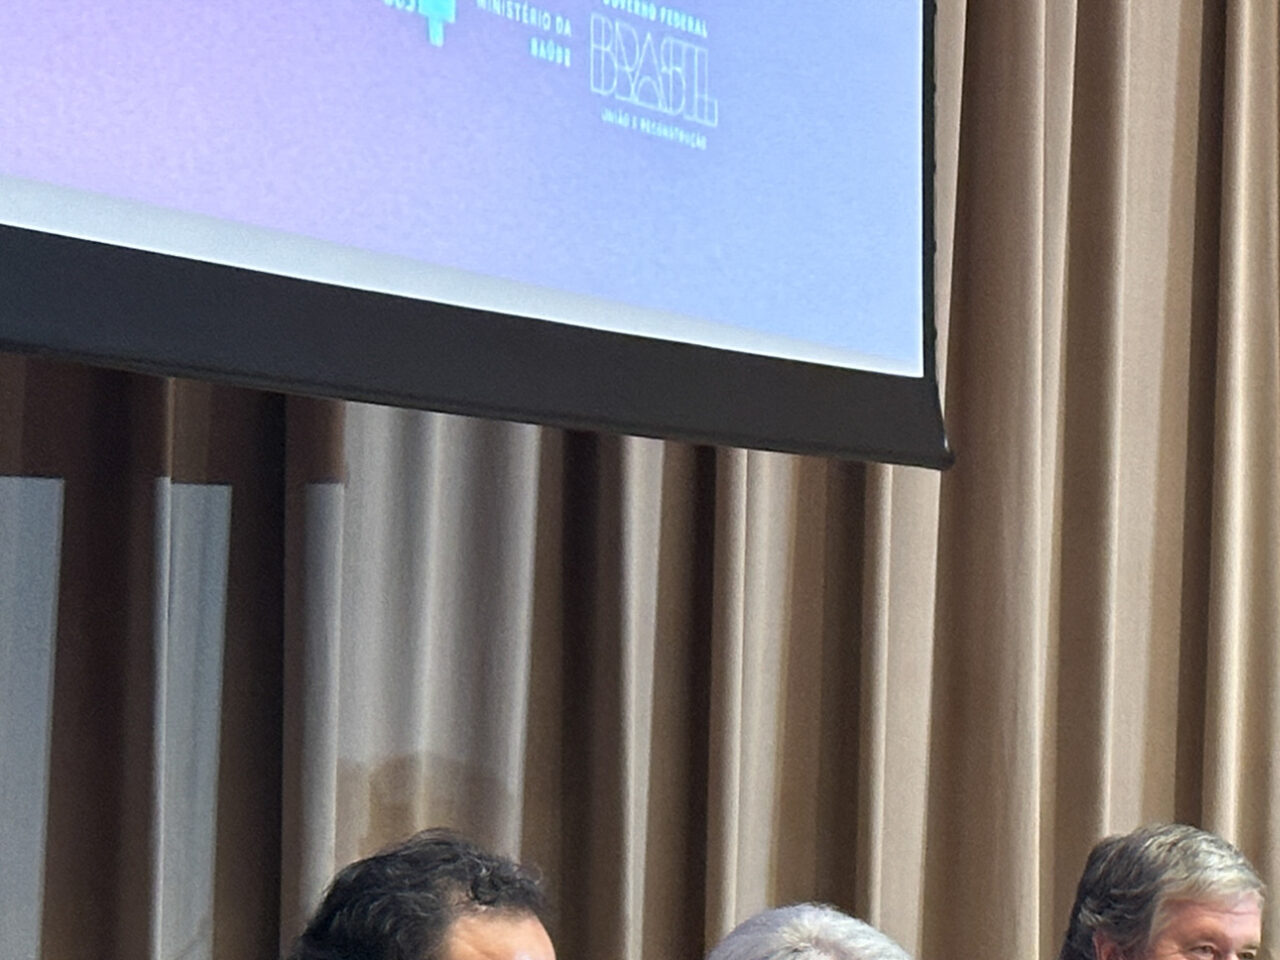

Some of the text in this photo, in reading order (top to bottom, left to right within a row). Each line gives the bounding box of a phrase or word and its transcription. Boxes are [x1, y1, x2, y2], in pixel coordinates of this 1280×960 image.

[556, 16, 572, 37] DA
[659, 6, 708, 38] FEDERAL
[590, 12, 718, 127] BRASIL
